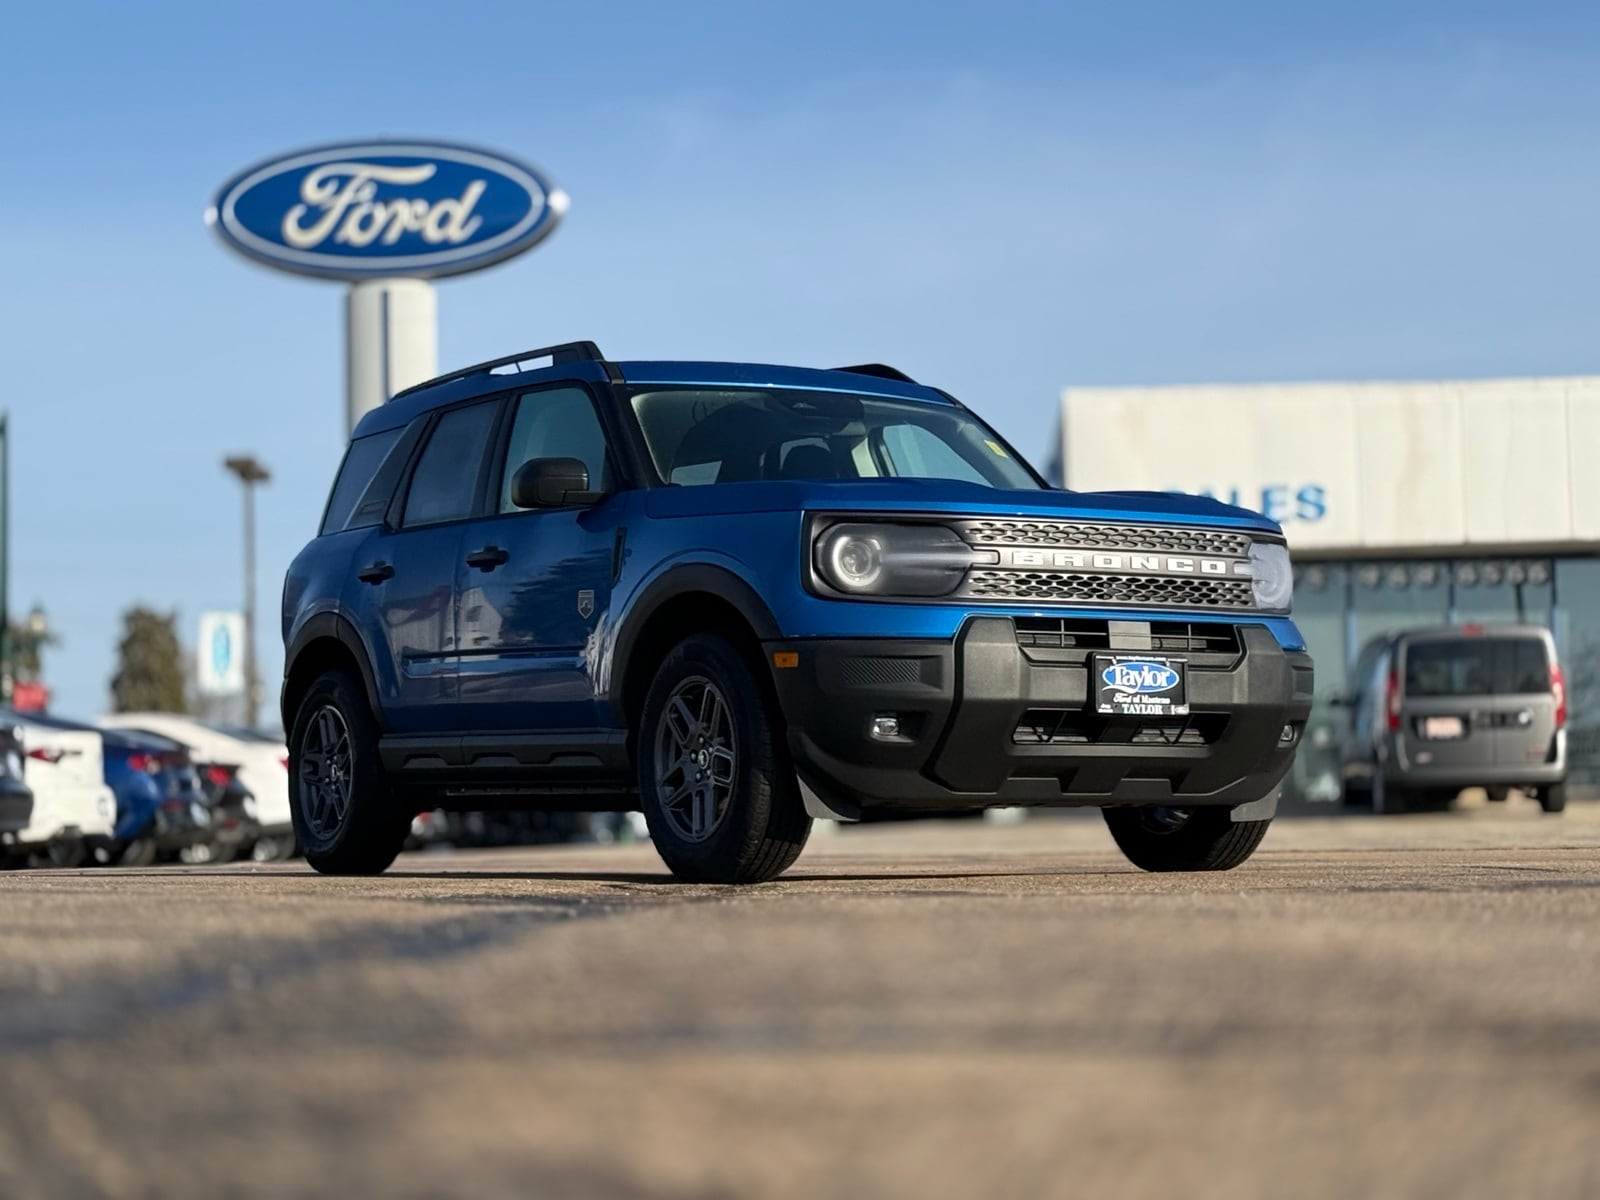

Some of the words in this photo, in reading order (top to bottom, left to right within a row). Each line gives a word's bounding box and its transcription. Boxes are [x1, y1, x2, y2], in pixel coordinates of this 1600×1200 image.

[281, 161, 488, 249] Ford
[1011, 550, 1227, 575] BRONCO
[1103, 665, 1171, 694] Taylor
[1121, 703, 1164, 715] TAYLOR
